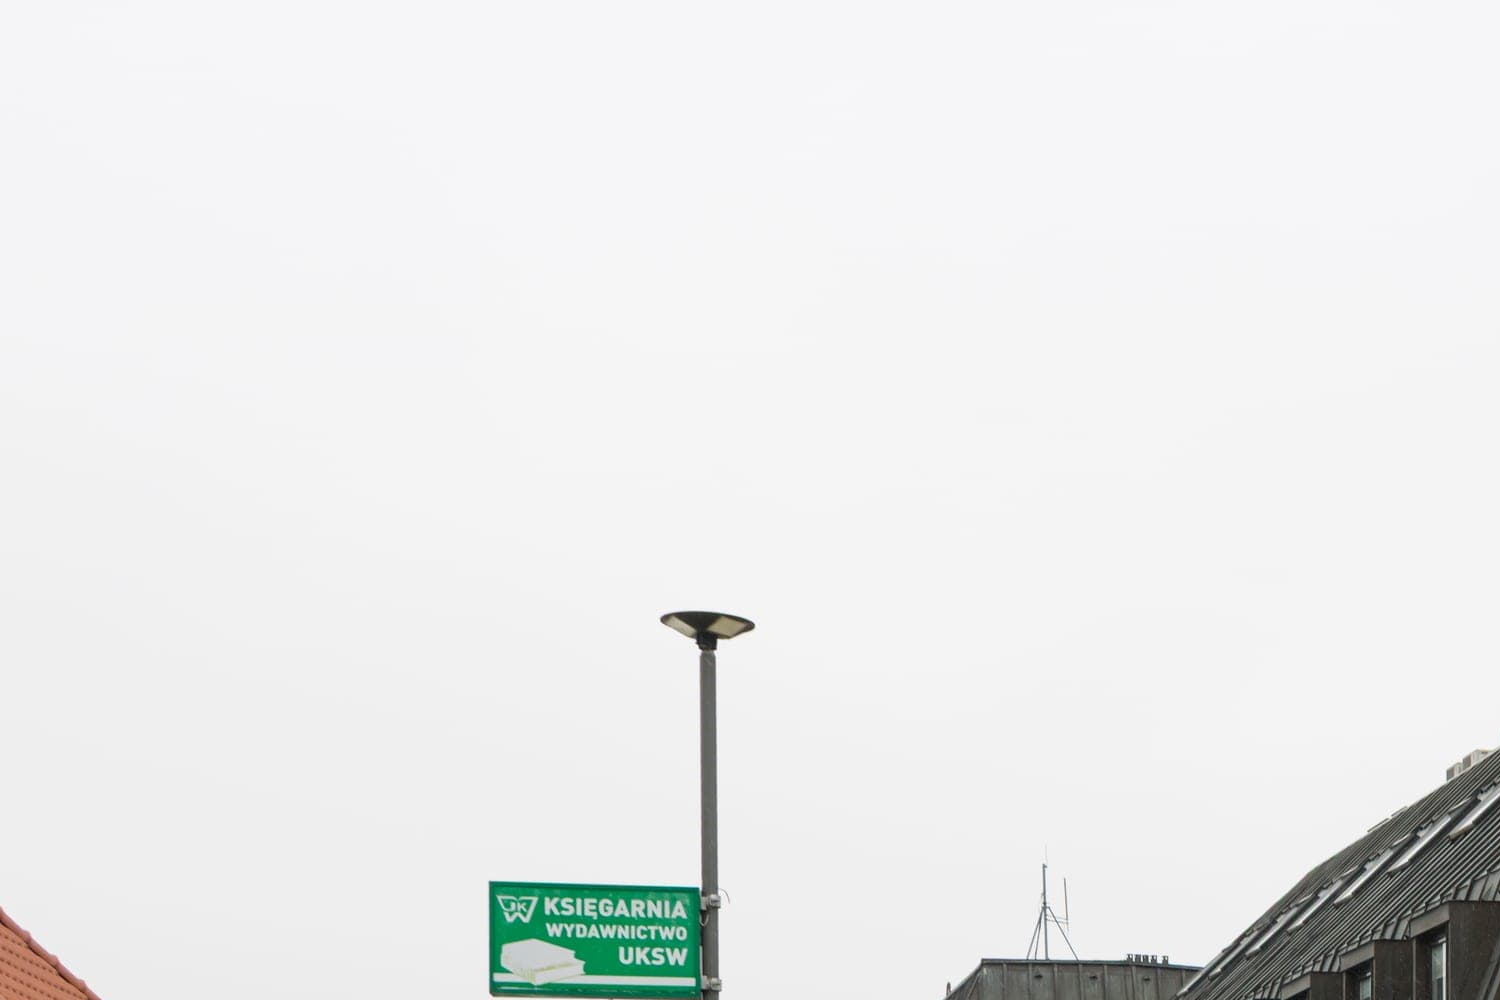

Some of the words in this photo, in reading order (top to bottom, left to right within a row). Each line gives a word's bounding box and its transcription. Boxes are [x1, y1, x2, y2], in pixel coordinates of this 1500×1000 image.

[544, 897, 688, 920] KSIĘGARNIA
[545, 923, 688, 941] WYDAWNICTWO
[619, 946, 688, 966] UKSW
